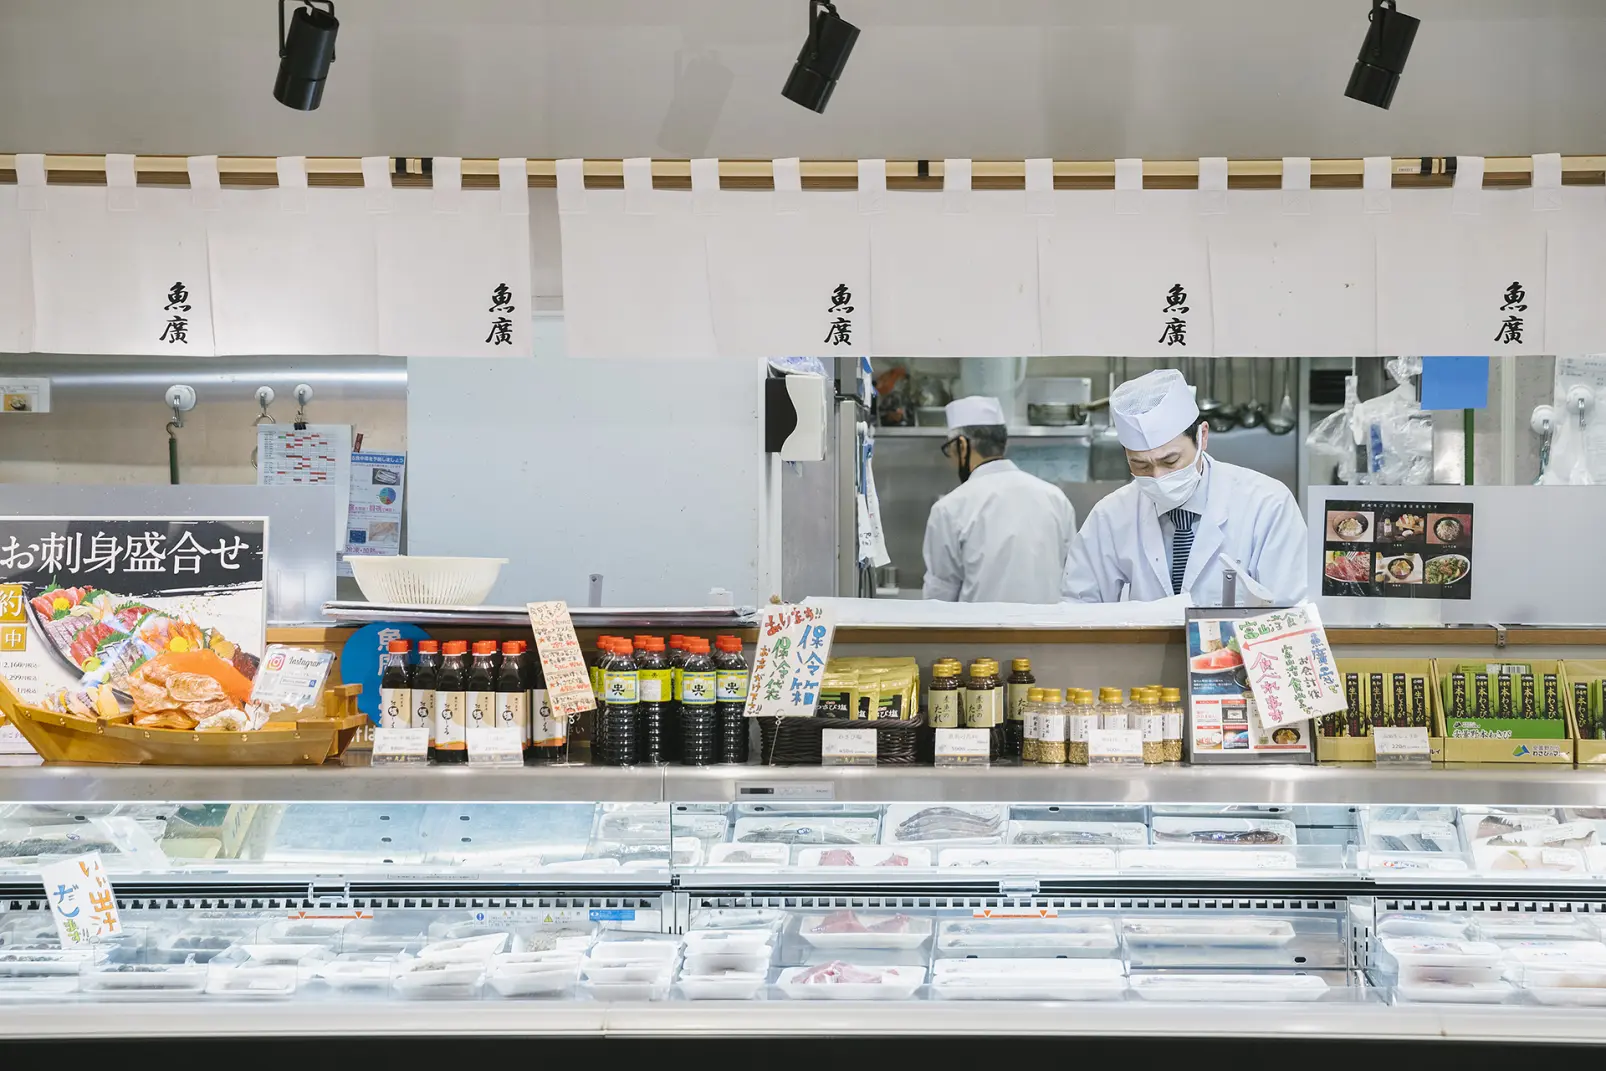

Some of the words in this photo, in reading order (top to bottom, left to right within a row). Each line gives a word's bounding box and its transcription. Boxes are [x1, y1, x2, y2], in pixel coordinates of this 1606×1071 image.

[159, 281, 192, 344] 魚廣
[485, 282, 515, 346] 魚廣
[823, 283, 855, 346] 魚廣
[1158, 283, 1190, 346] 魚廣
[1493, 281, 1528, 345] 魚廣
[1, 530, 250, 575] お刺身盛合せ
[5, 628, 22, 648] 中
[789, 624, 827, 706] 保冷箱
[934, 704, 942, 723] たれ
[968, 704, 976, 723] たれ
[1454, 687, 1464, 718] 本わさび
[1478, 687, 1488, 718] 本わさび
[1500, 687, 1510, 718] 本わさび
[1524, 687, 1534, 718] 本わさび
[1546, 687, 1556, 718] 本わさび
[1576, 696, 1587, 727] 本わさび
